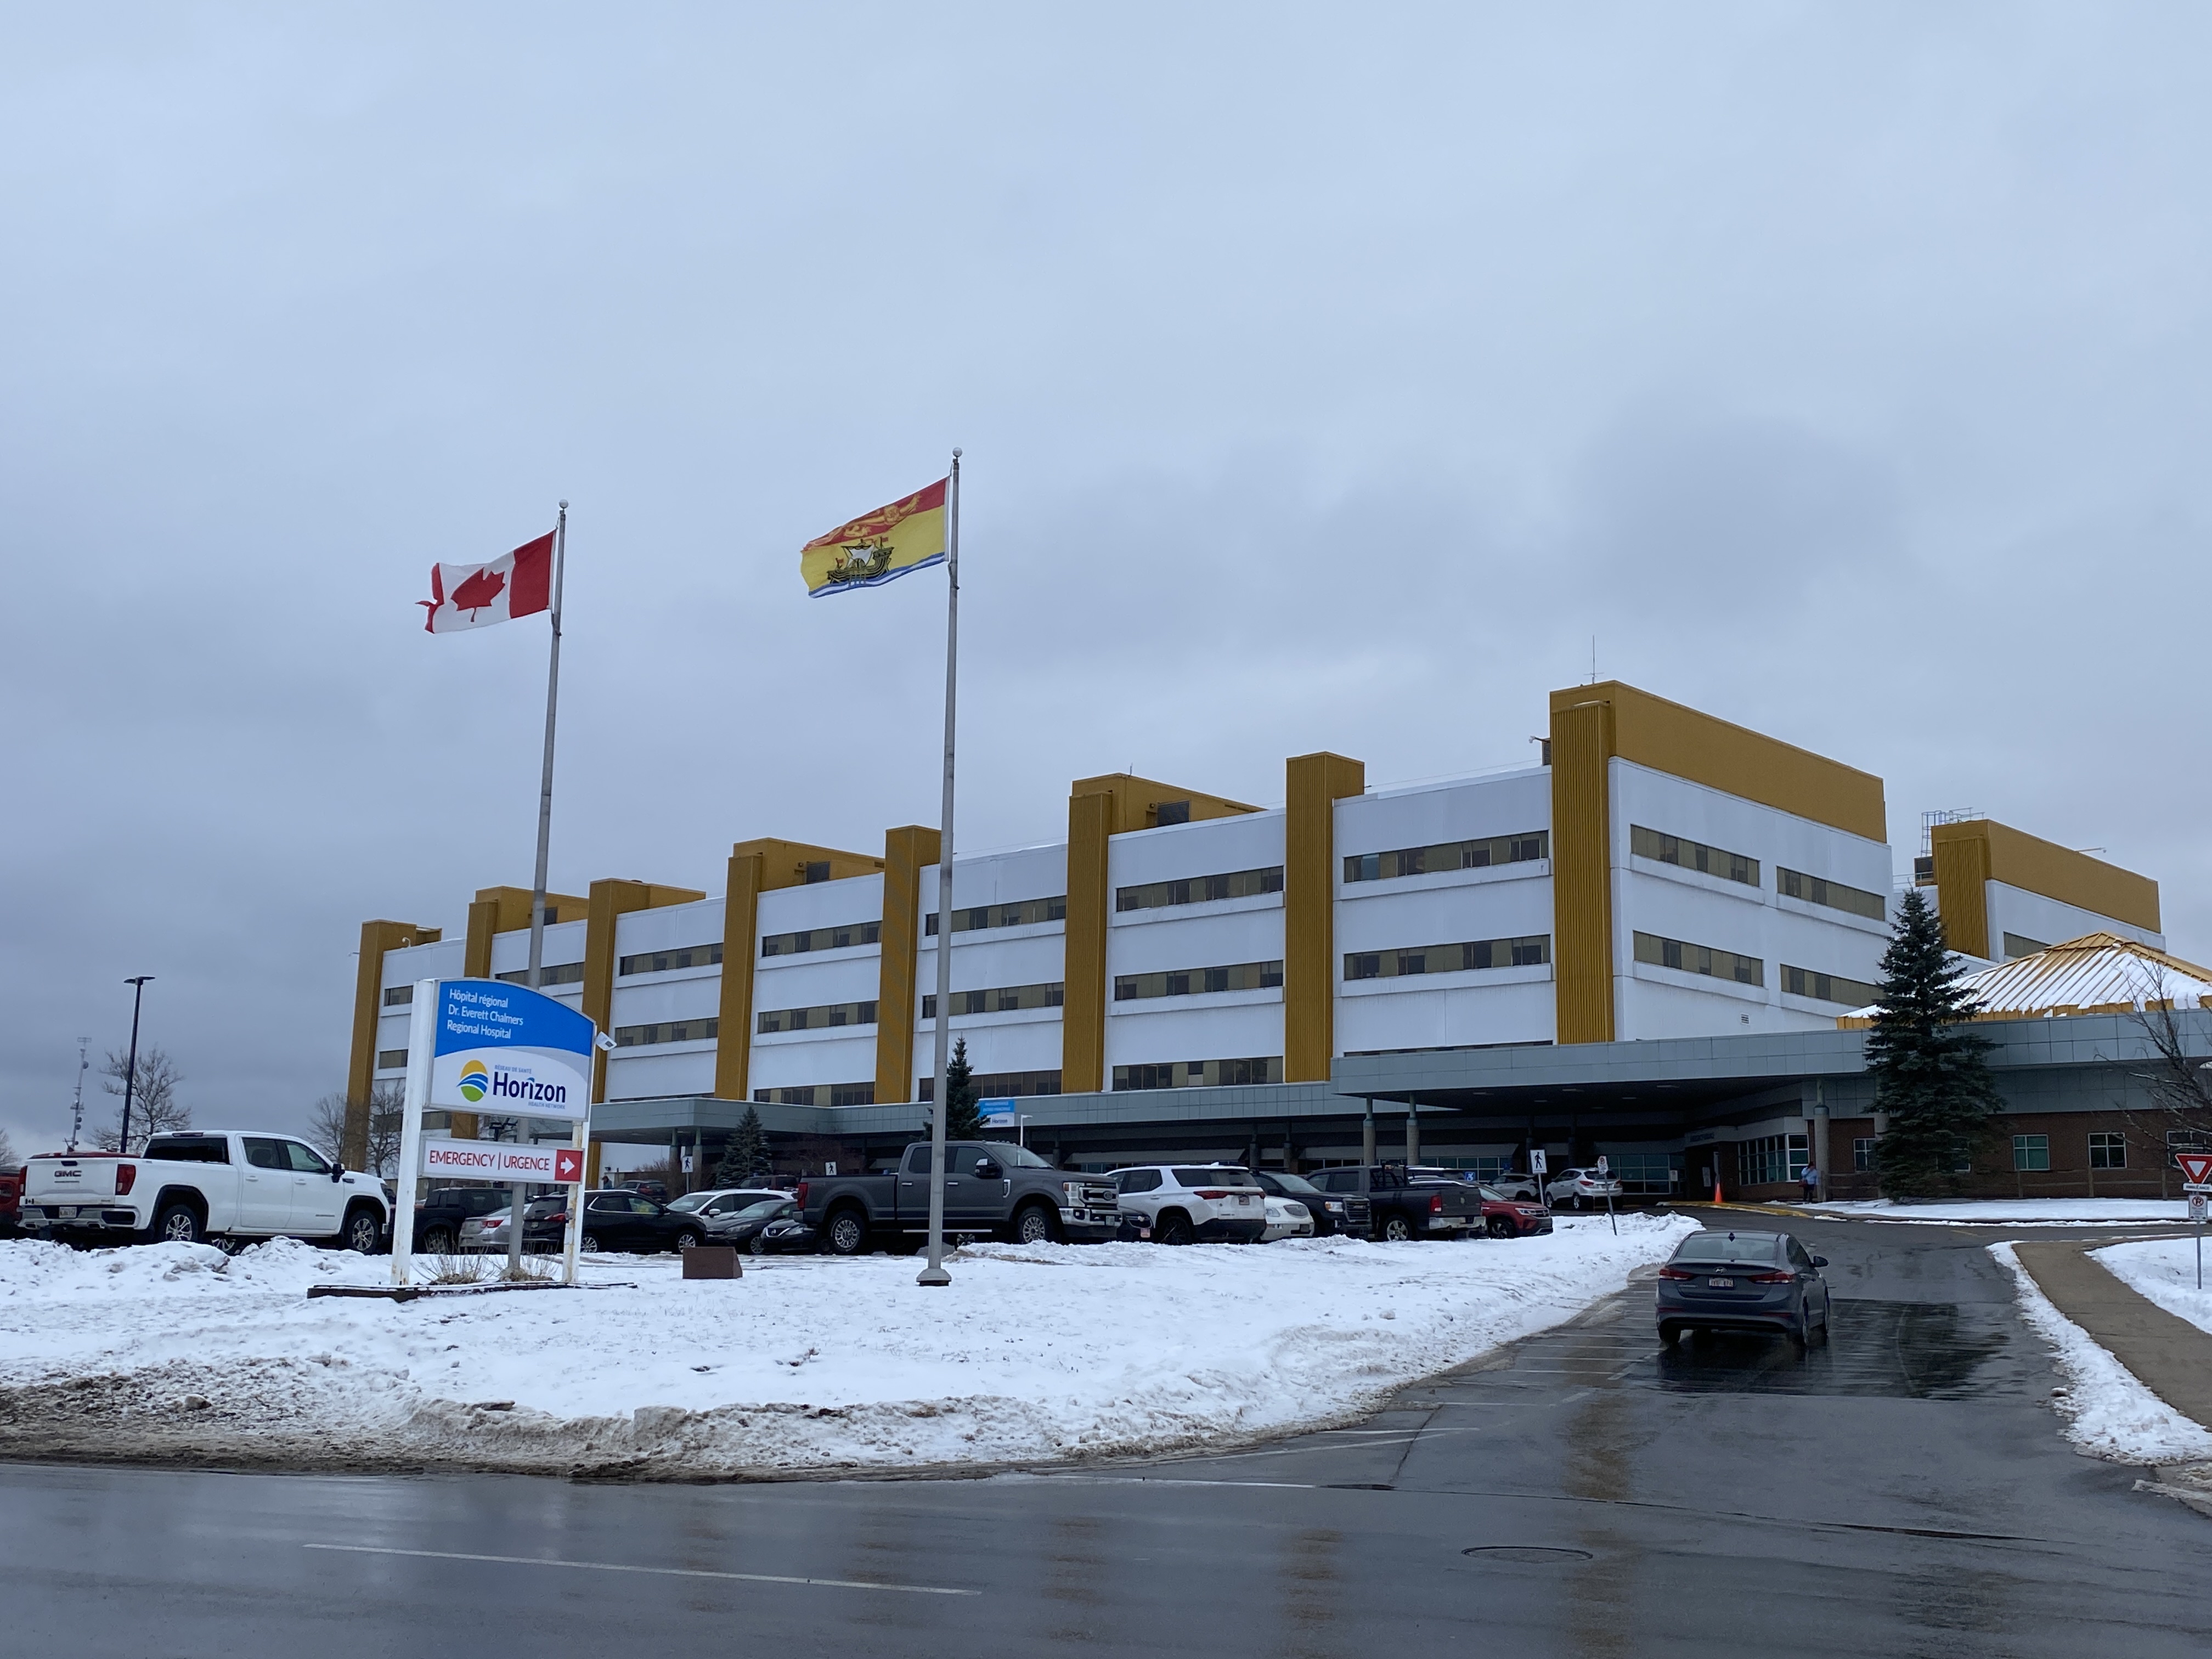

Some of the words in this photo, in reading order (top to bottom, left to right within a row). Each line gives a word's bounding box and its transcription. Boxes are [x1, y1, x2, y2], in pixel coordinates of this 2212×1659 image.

[449, 988, 478, 1003] Hôpital
[478, 994, 509, 1007] régional
[448, 1004, 460, 1015] Dr.
[461, 1006, 489, 1020] Everett
[489, 1011, 524, 1025] Chalmers
[447, 1019, 480, 1034] Regional
[481, 1024, 511, 1039] Hospital
[493, 1071, 566, 1103] Horizon
[430, 1150, 495, 1167] EMERGENCY
[504, 1155, 550, 1171] URGENCE
